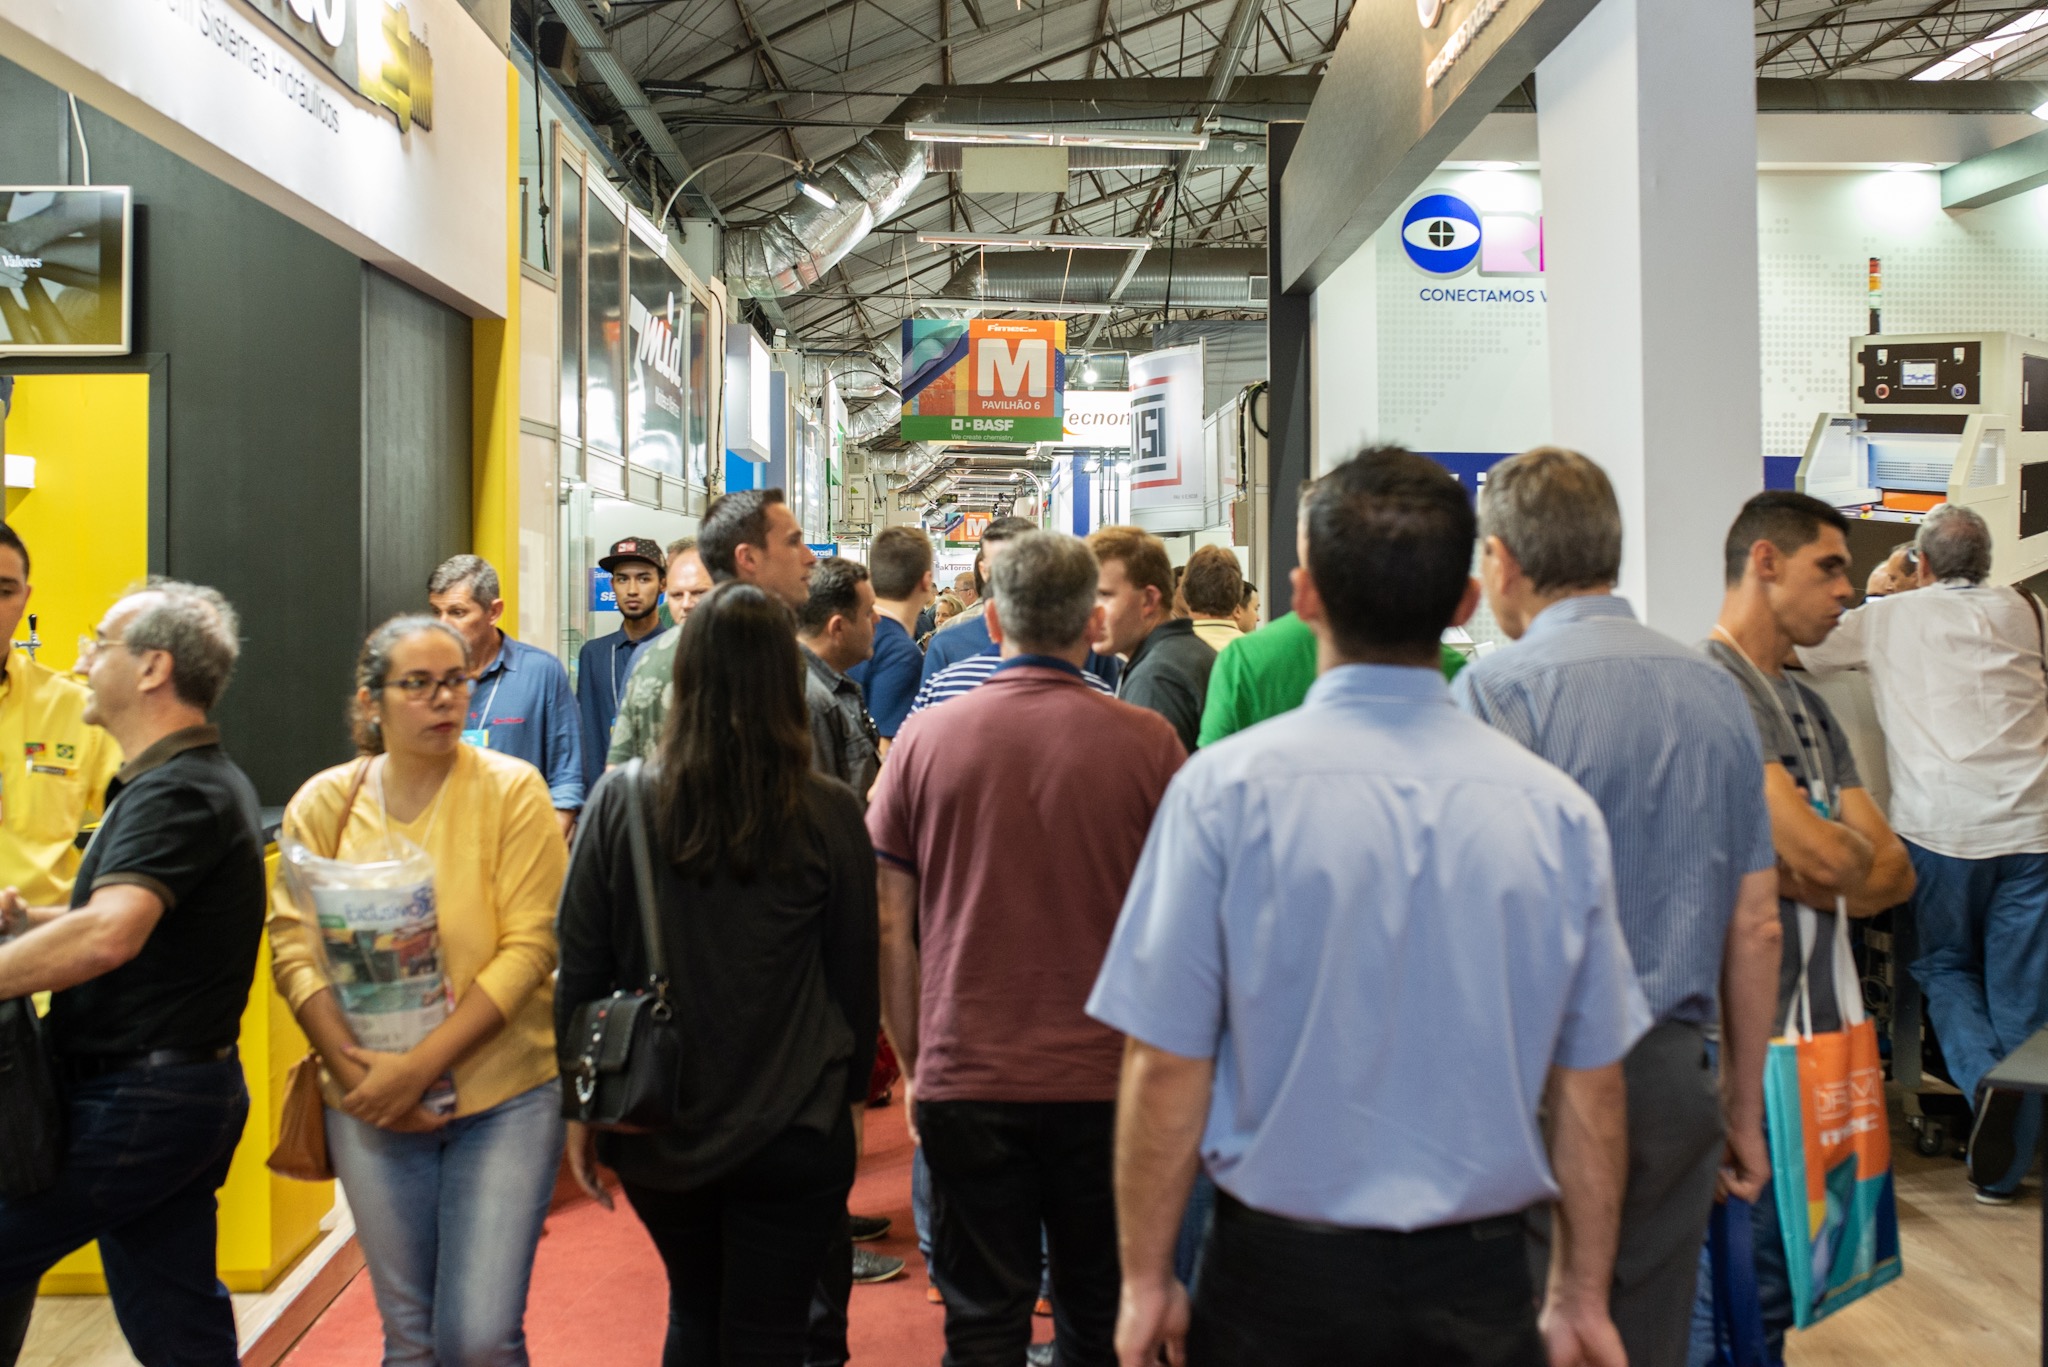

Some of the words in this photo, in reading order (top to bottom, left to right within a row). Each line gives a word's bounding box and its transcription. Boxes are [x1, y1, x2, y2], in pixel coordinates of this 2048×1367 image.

[200, 1, 267, 80] Sistemas
[272, 50, 339, 133] Hidráulicos
[2, 254, 43, 268] Valores
[1419, 288, 1535, 303] CONECTAMOS
[977, 337, 1048, 398] M
[981, 399, 1032, 410] PAVILHÃO
[1034, 401, 1041, 410] 6
[973, 419, 1014, 431] BASF
[966, 518, 988, 536] M
